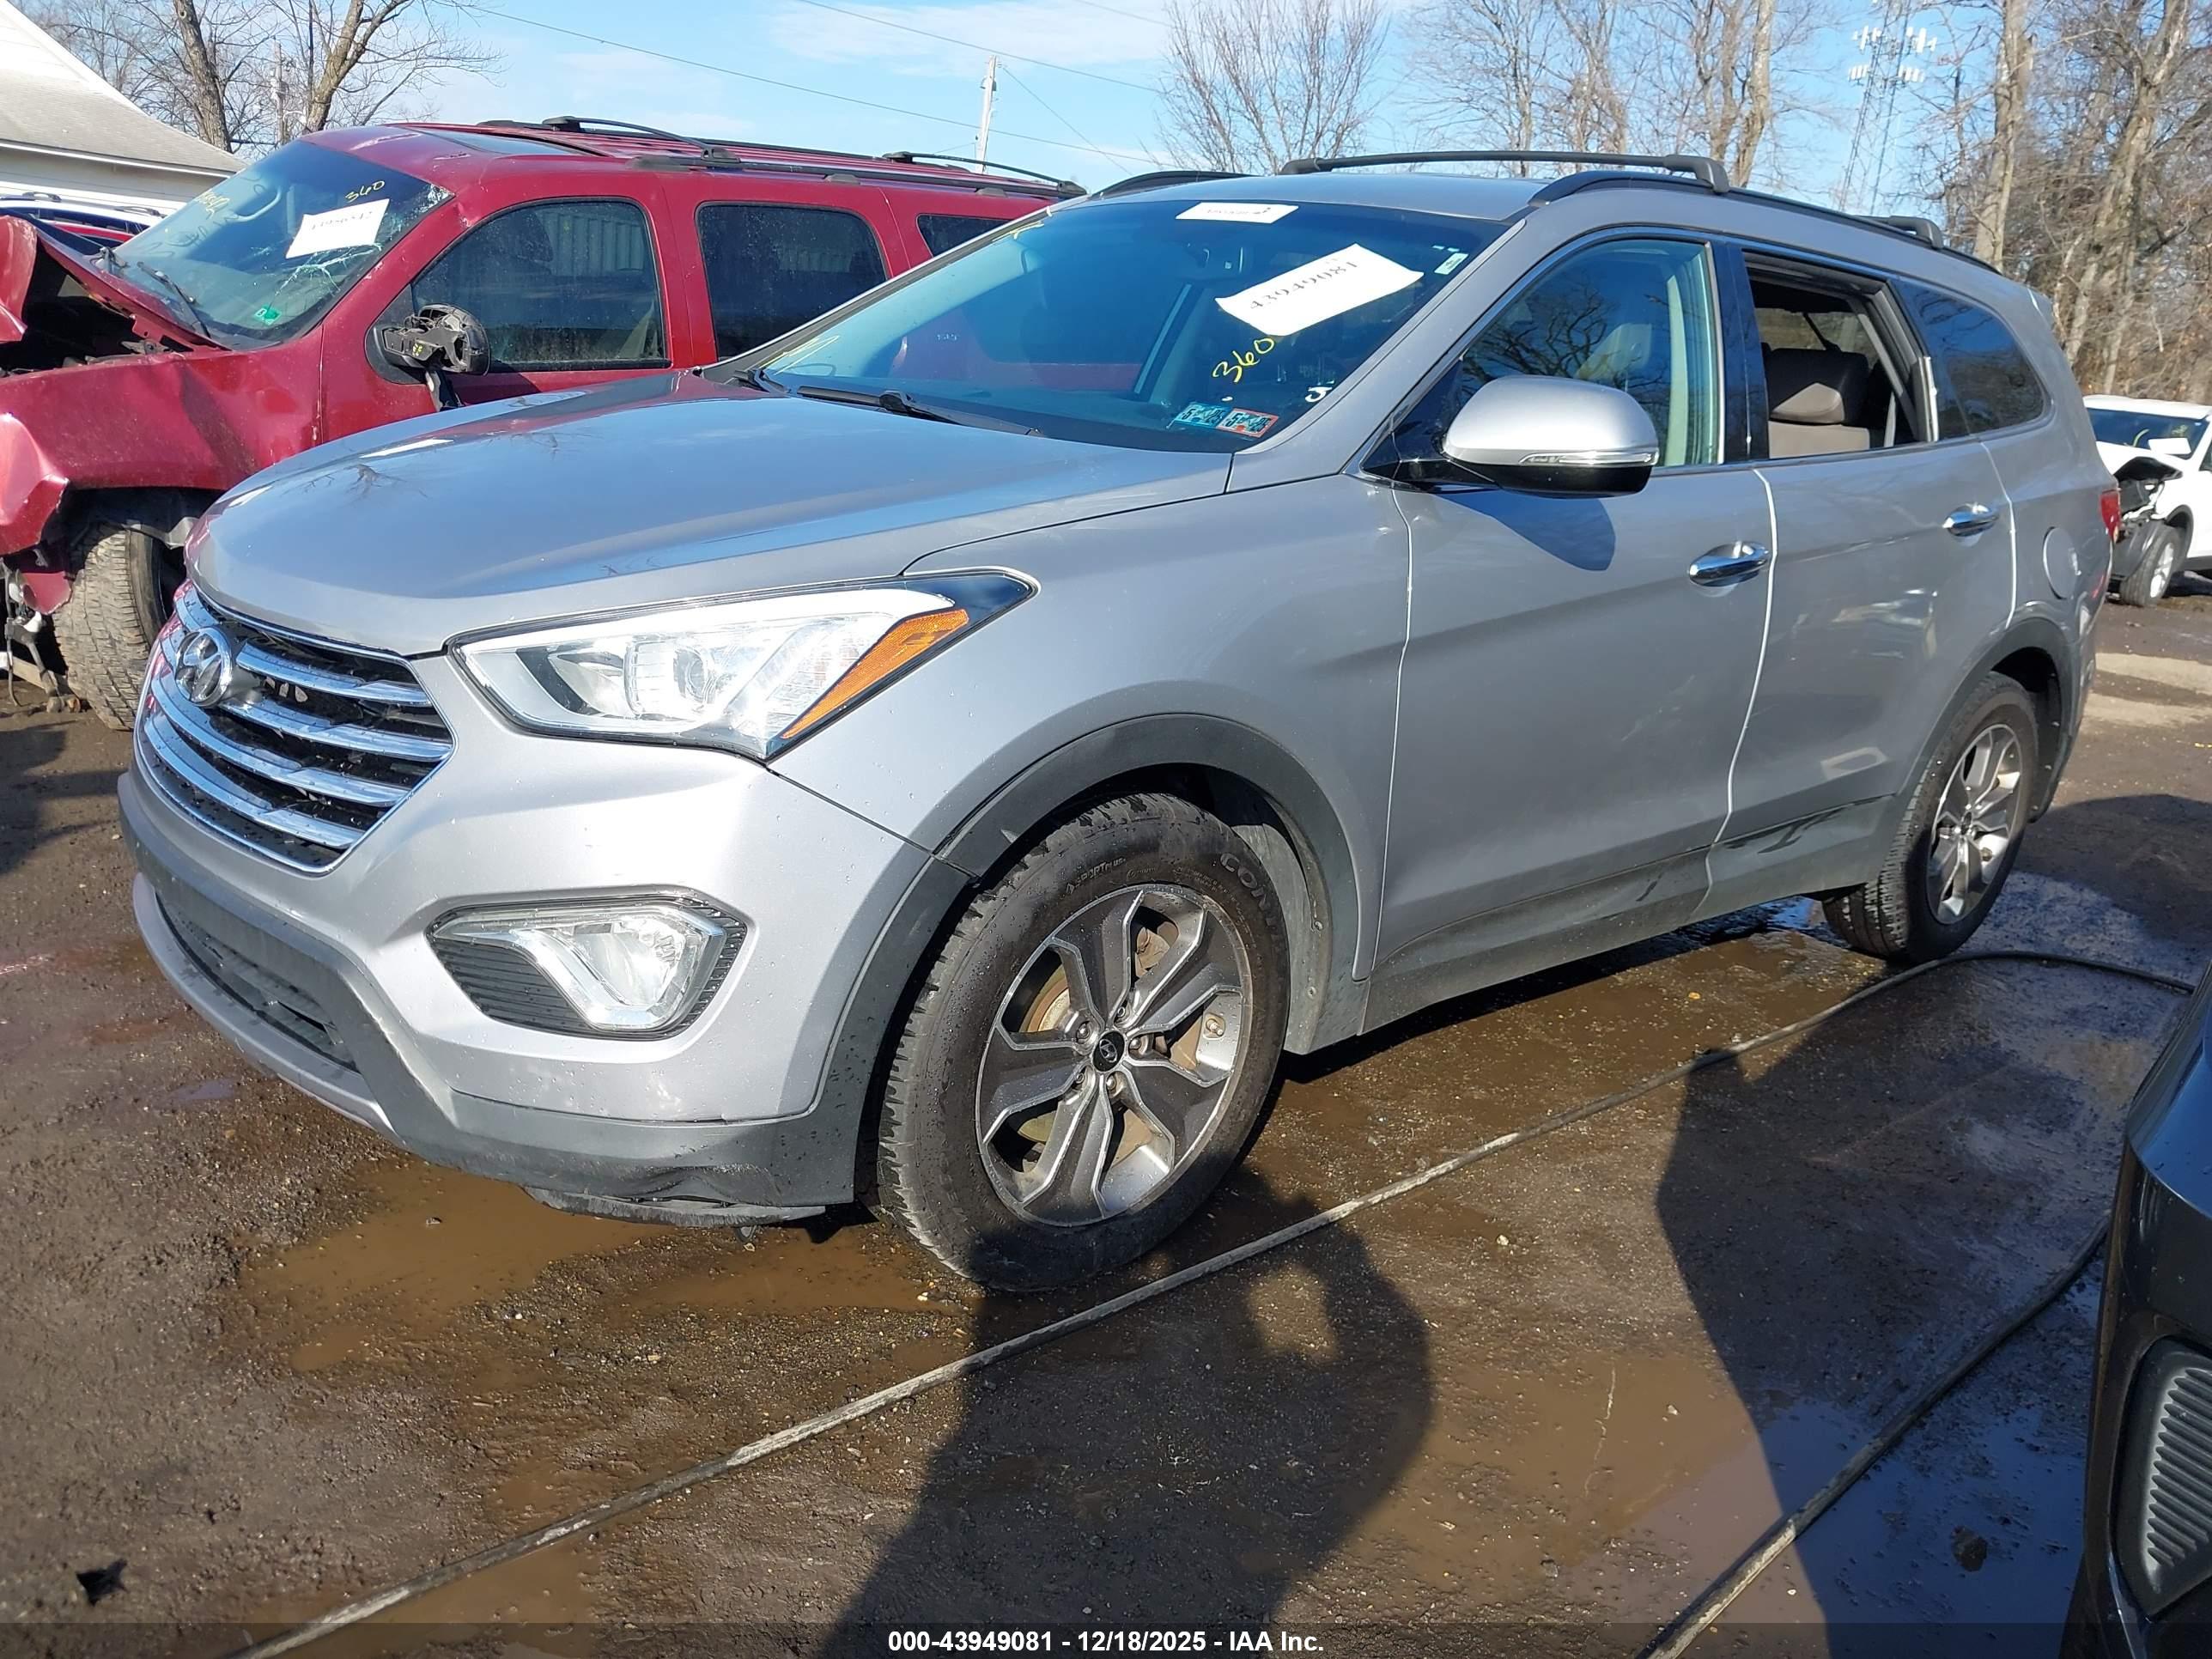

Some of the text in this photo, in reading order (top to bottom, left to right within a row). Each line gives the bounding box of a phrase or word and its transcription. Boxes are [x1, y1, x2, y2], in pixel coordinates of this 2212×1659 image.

[345, 180, 386, 203] 360
[1249, 260, 1358, 309] 43949081
[1212, 337, 1275, 384] 360
